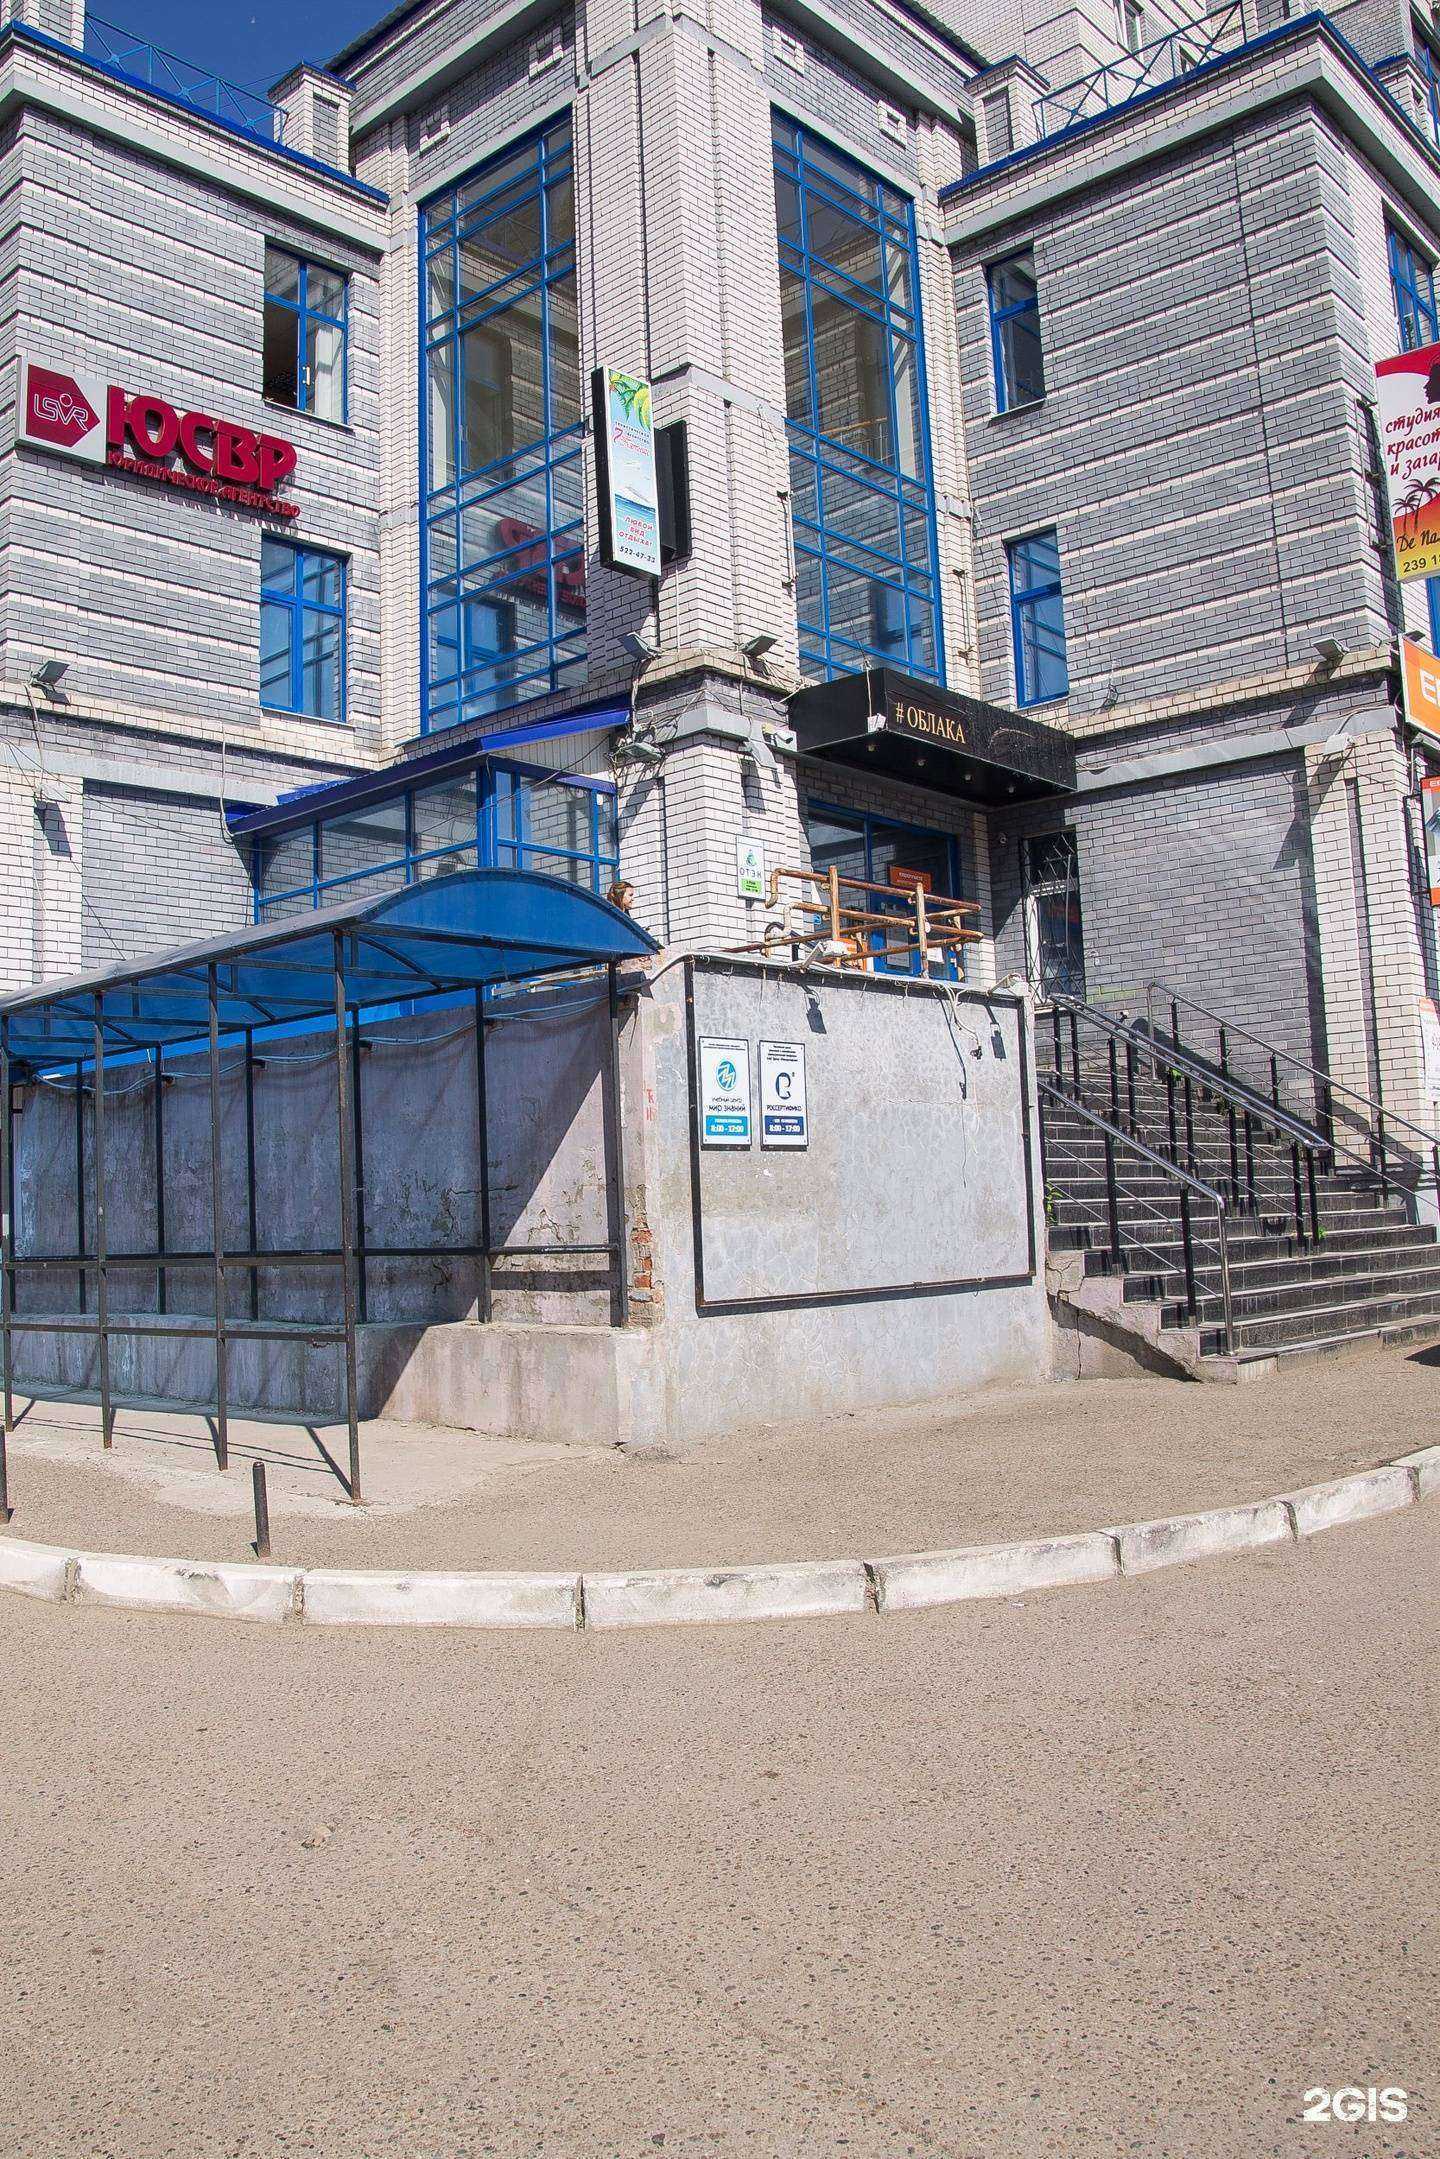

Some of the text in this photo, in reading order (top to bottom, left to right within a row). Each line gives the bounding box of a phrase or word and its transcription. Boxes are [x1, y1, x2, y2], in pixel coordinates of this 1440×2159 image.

[1386, 406, 1440, 436] студия
[107, 384, 297, 490] ЮСВР
[1390, 462, 1399, 475] и
[629, 526, 644, 537] ВИД
[1403, 557, 1427, 573] 239
